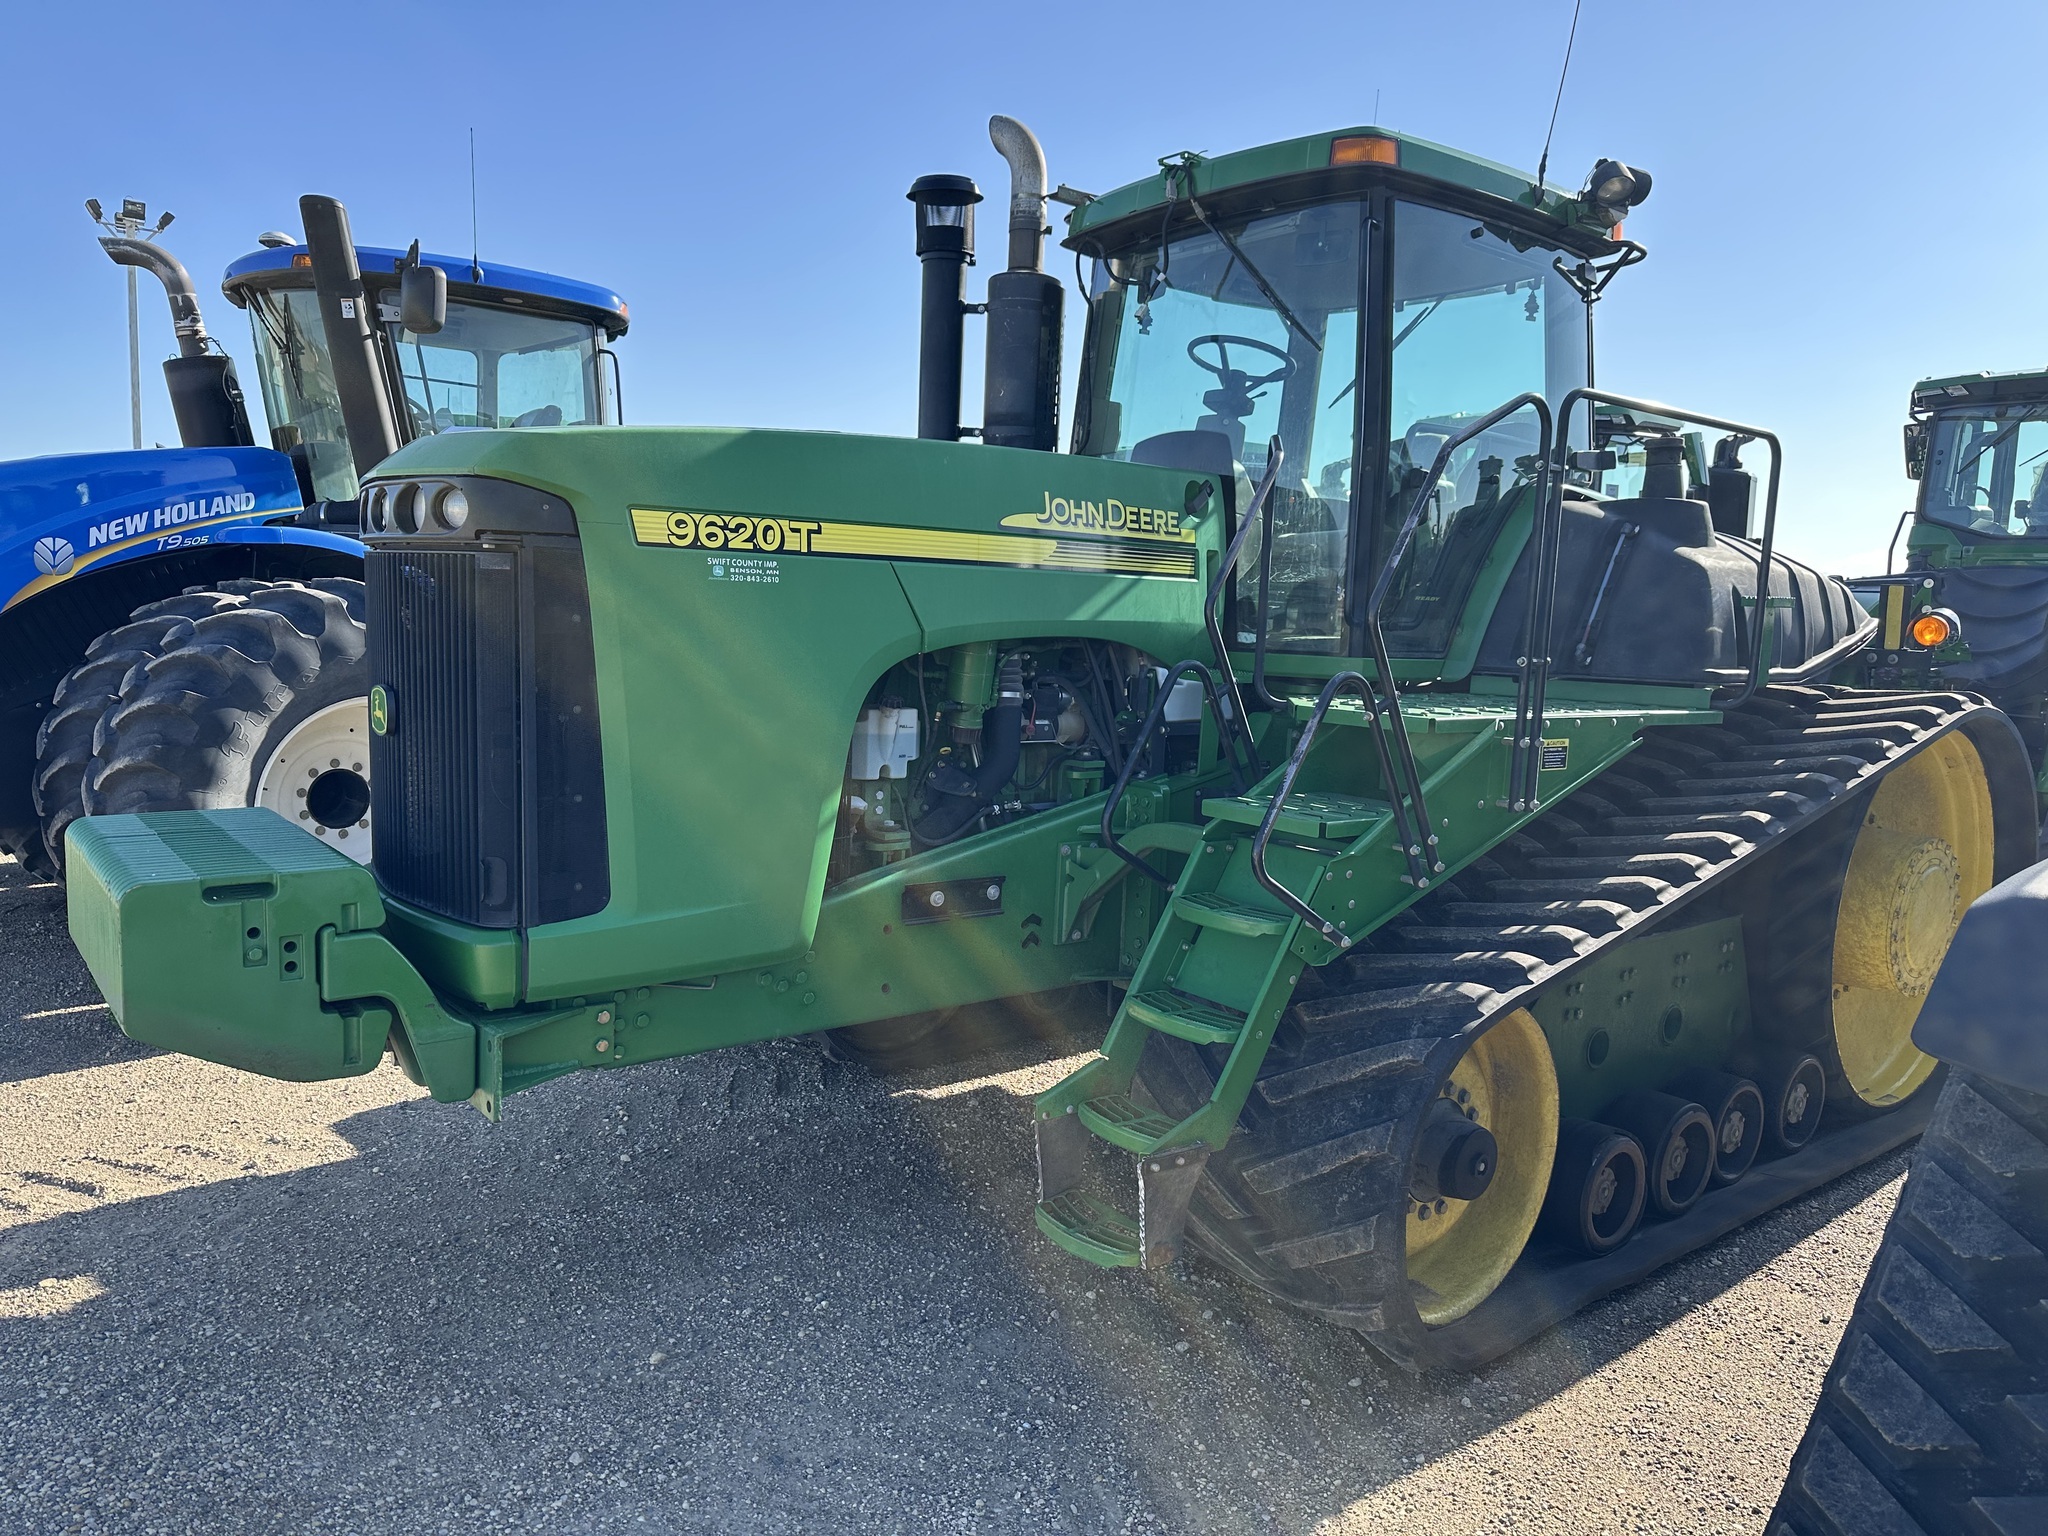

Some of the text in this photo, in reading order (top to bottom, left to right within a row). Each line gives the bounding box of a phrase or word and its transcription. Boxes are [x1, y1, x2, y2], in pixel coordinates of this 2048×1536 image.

[88, 492, 256, 548] NEW HOLLAND
[667, 511, 823, 553] 9620T
[157, 534, 210, 551] T9.505
[707, 557, 779, 569] SWIFT COUNTY IMP.
[730, 567, 765, 575] BENSON,
[730, 574, 780, 583] 320-843-2610
